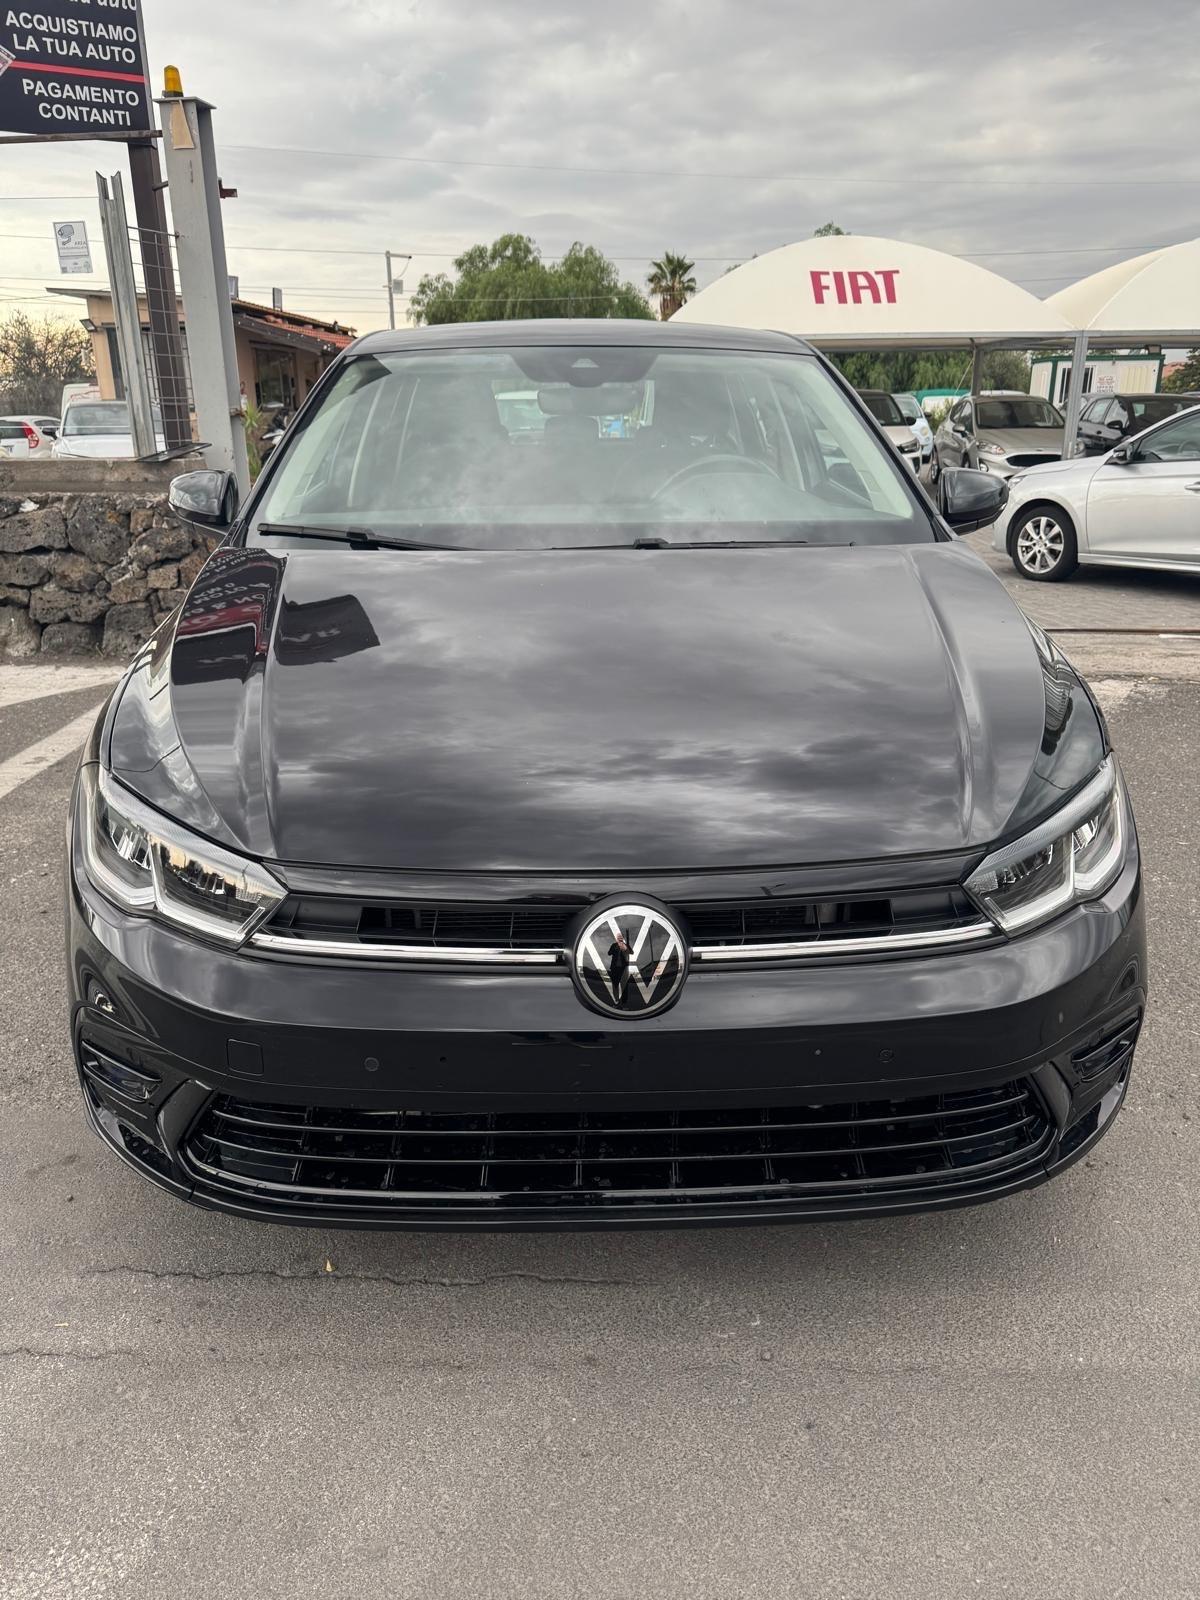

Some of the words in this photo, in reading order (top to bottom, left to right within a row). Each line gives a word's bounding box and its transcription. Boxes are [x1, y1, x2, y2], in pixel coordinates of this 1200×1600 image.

[6, 10, 137, 42] ACQUISTIAMO
[13, 34, 40, 52] LA
[42, 37, 82, 57] TUA
[86, 43, 136, 63] AUTO
[22, 79, 139, 106] PAGAMENTO
[38, 103, 131, 126] CONTANTI
[809, 270, 900, 304] FIAT
